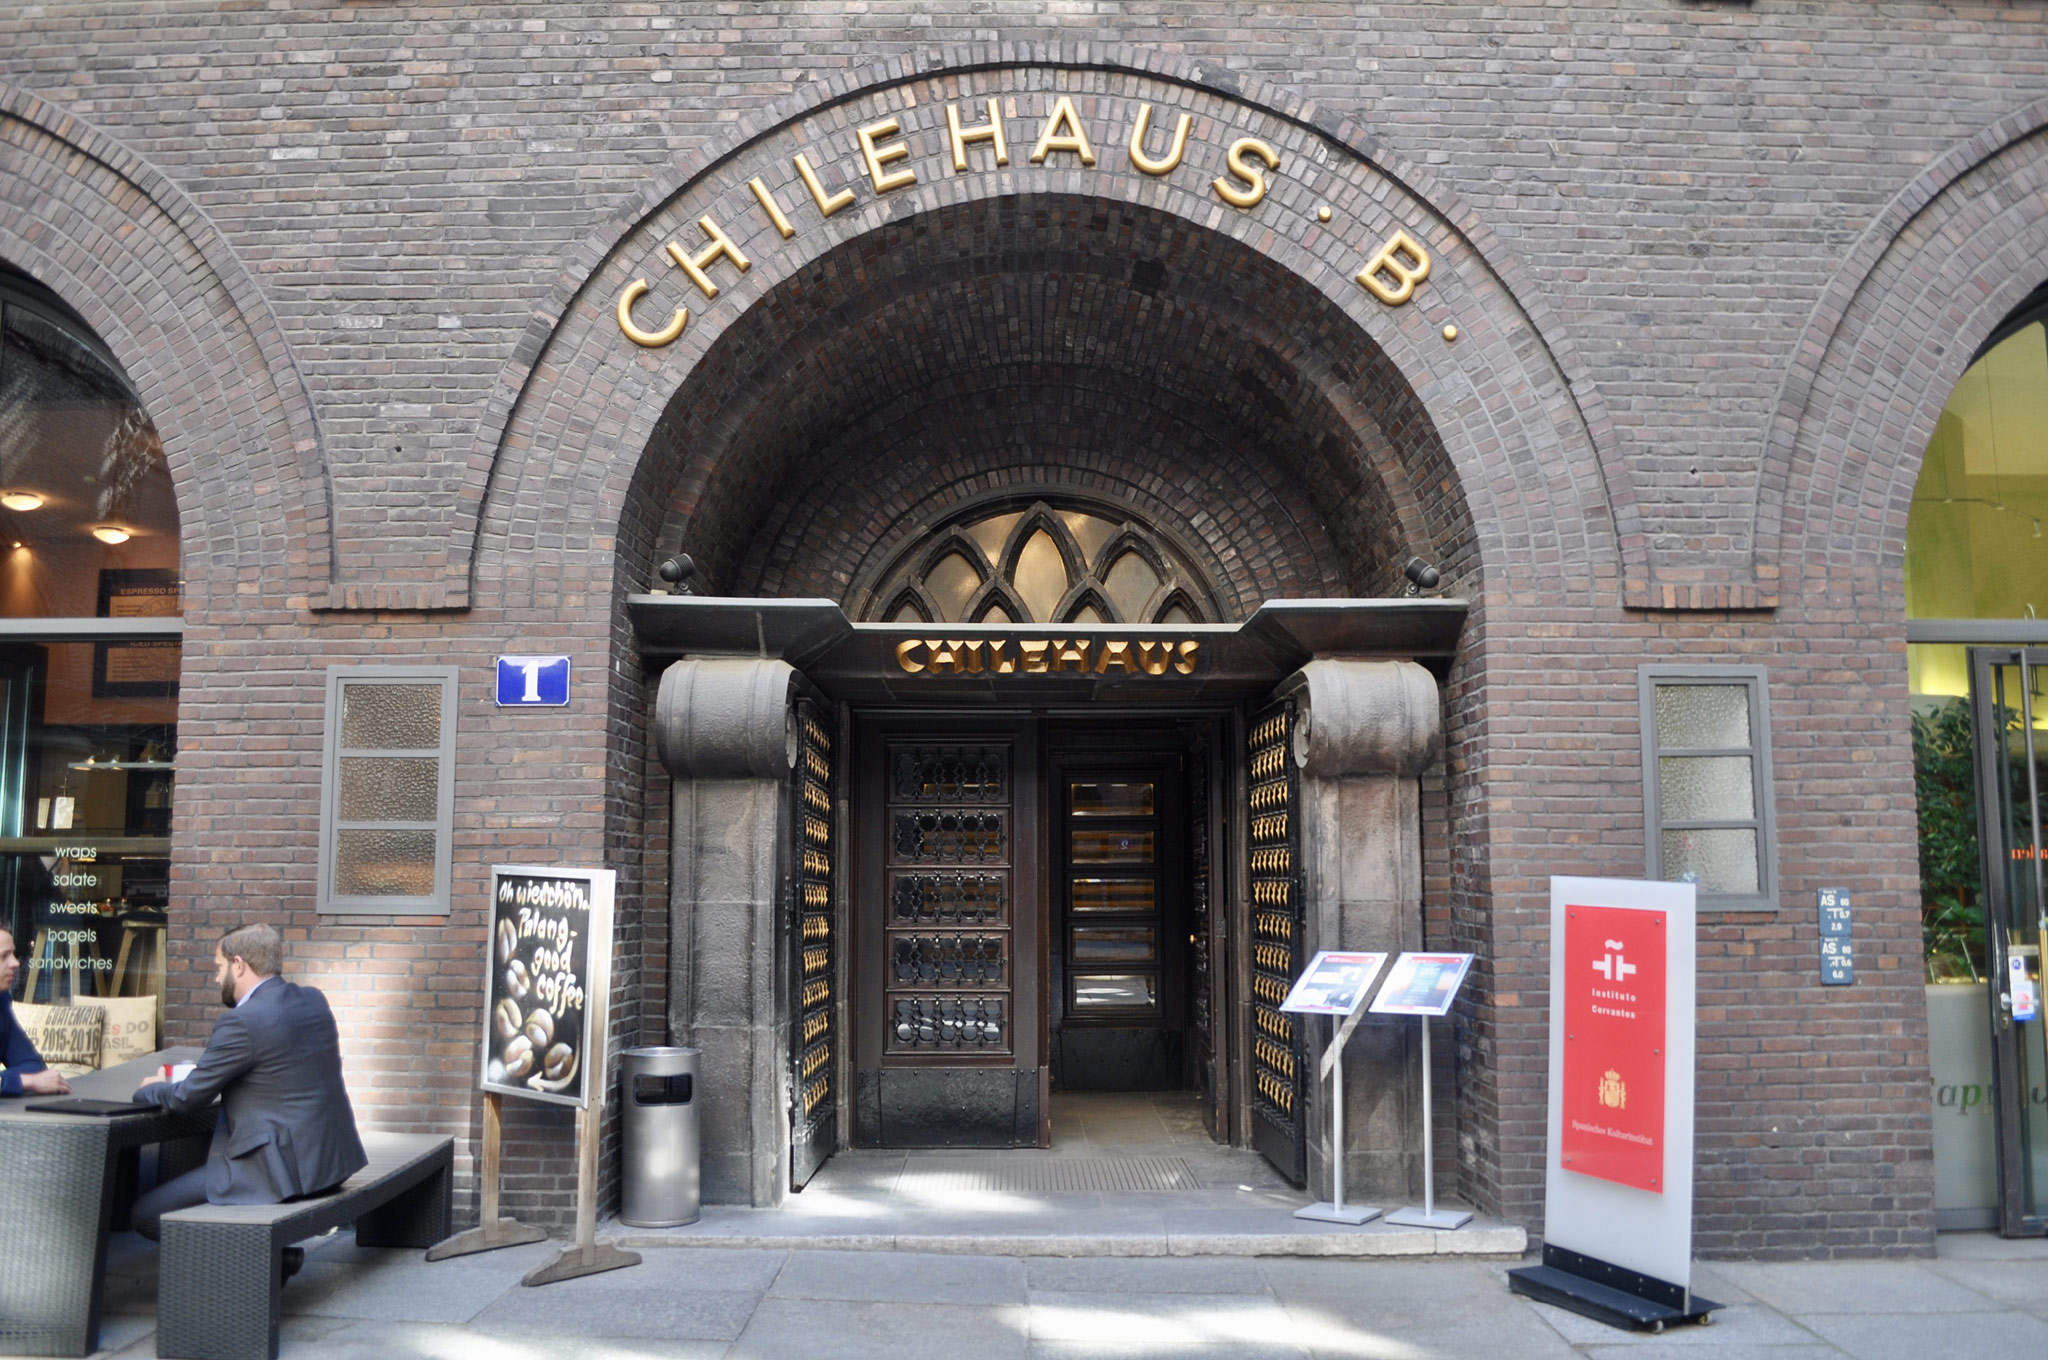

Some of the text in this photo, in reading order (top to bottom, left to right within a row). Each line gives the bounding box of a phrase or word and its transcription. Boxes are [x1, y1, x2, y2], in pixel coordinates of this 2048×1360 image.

[616, 96, 1280, 349] CHILEHAUS
[120, 587, 166, 596] ESPRESSO
[896, 638, 1200, 675] CHILEHAUS
[521, 659, 542, 702] 1
[55, 846, 97, 862] wraps
[53, 872, 97, 887] salate
[499, 880, 514, 904] Oh
[50, 901, 98, 914] sweets
[1820, 894, 1836, 907] AS
[47, 928, 97, 945] bagels
[1822, 942, 1837, 955] AS
[28, 955, 113, 971] sandwiches
[531, 940, 573, 977] good
[536, 971, 584, 1019] coffee
[1592, 988, 1637, 1002] Instituto
[1591, 1004, 1637, 1019] Cervantes
[1572, 1119, 1653, 1146] Spanisches Kulturinstitut
